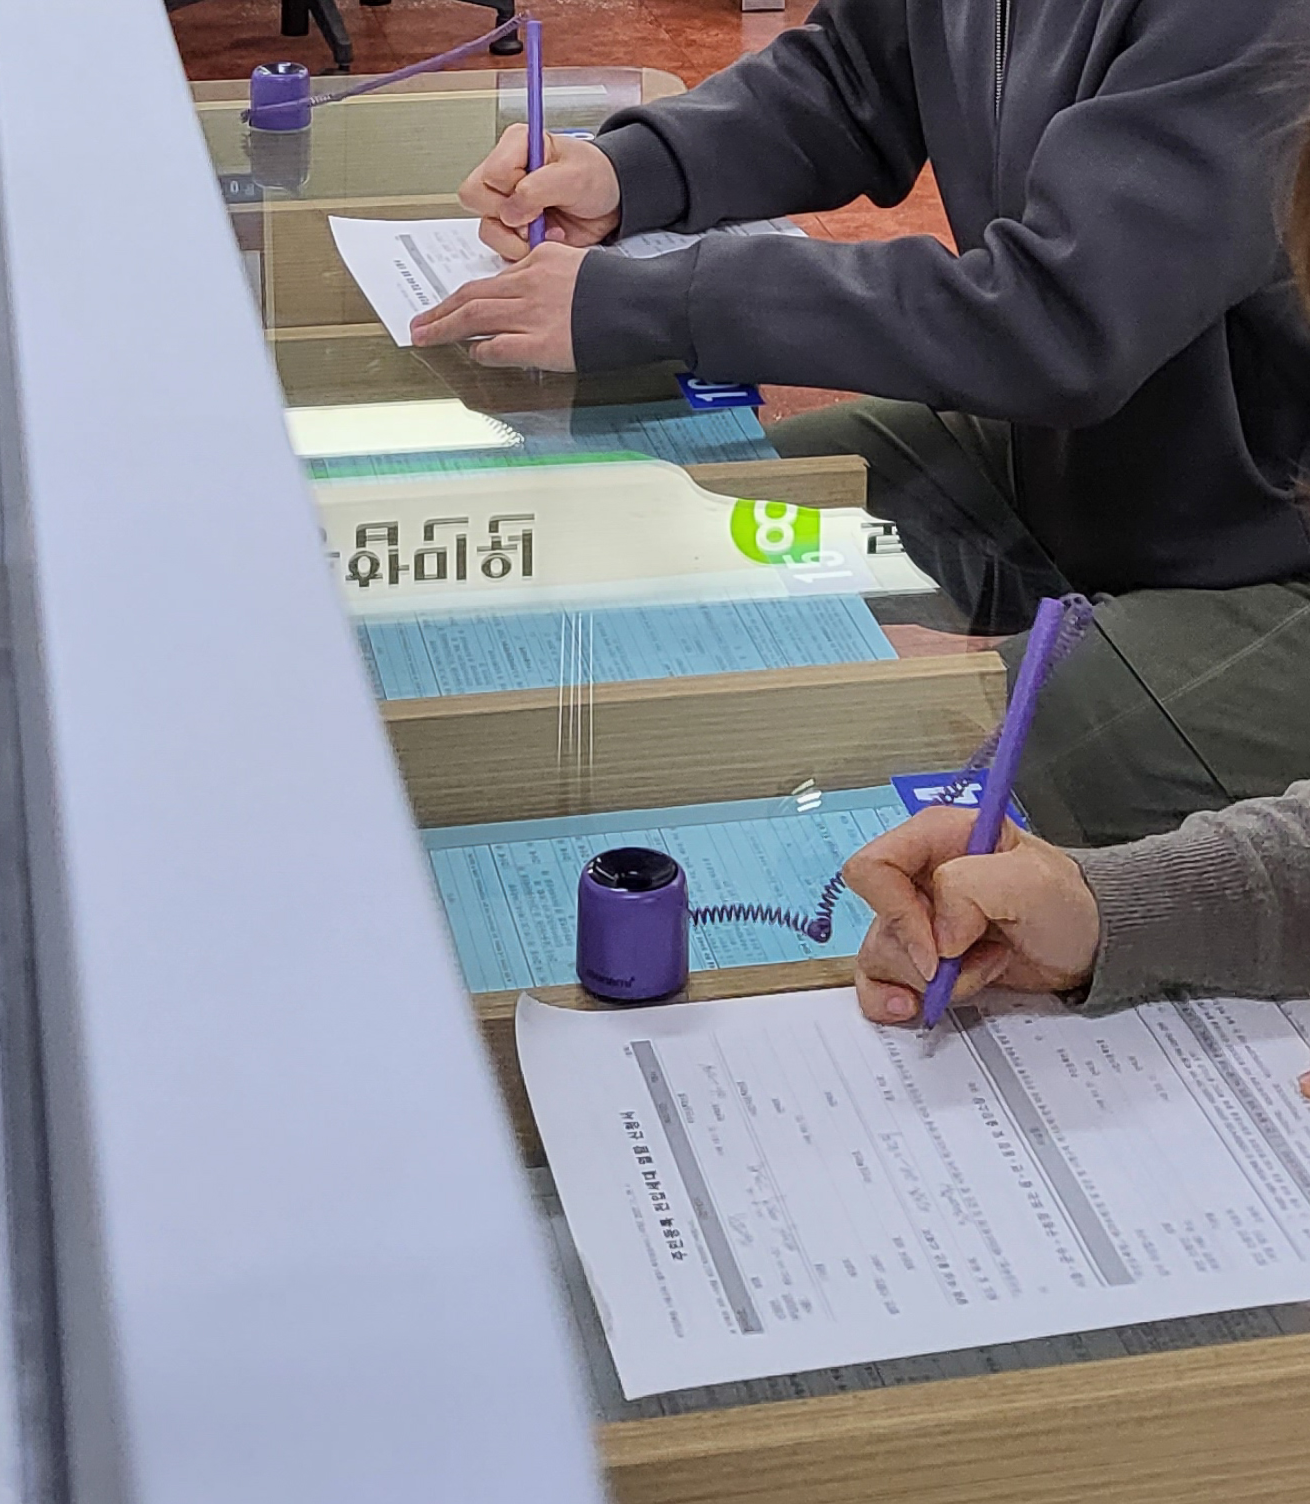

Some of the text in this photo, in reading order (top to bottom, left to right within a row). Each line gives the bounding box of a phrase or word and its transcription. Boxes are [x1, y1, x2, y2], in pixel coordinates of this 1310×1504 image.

[619, 1111, 644, 1140] 신청서
[641, 1170, 670, 1212] 전입세대
[659, 1217, 688, 1261] 주민등록
